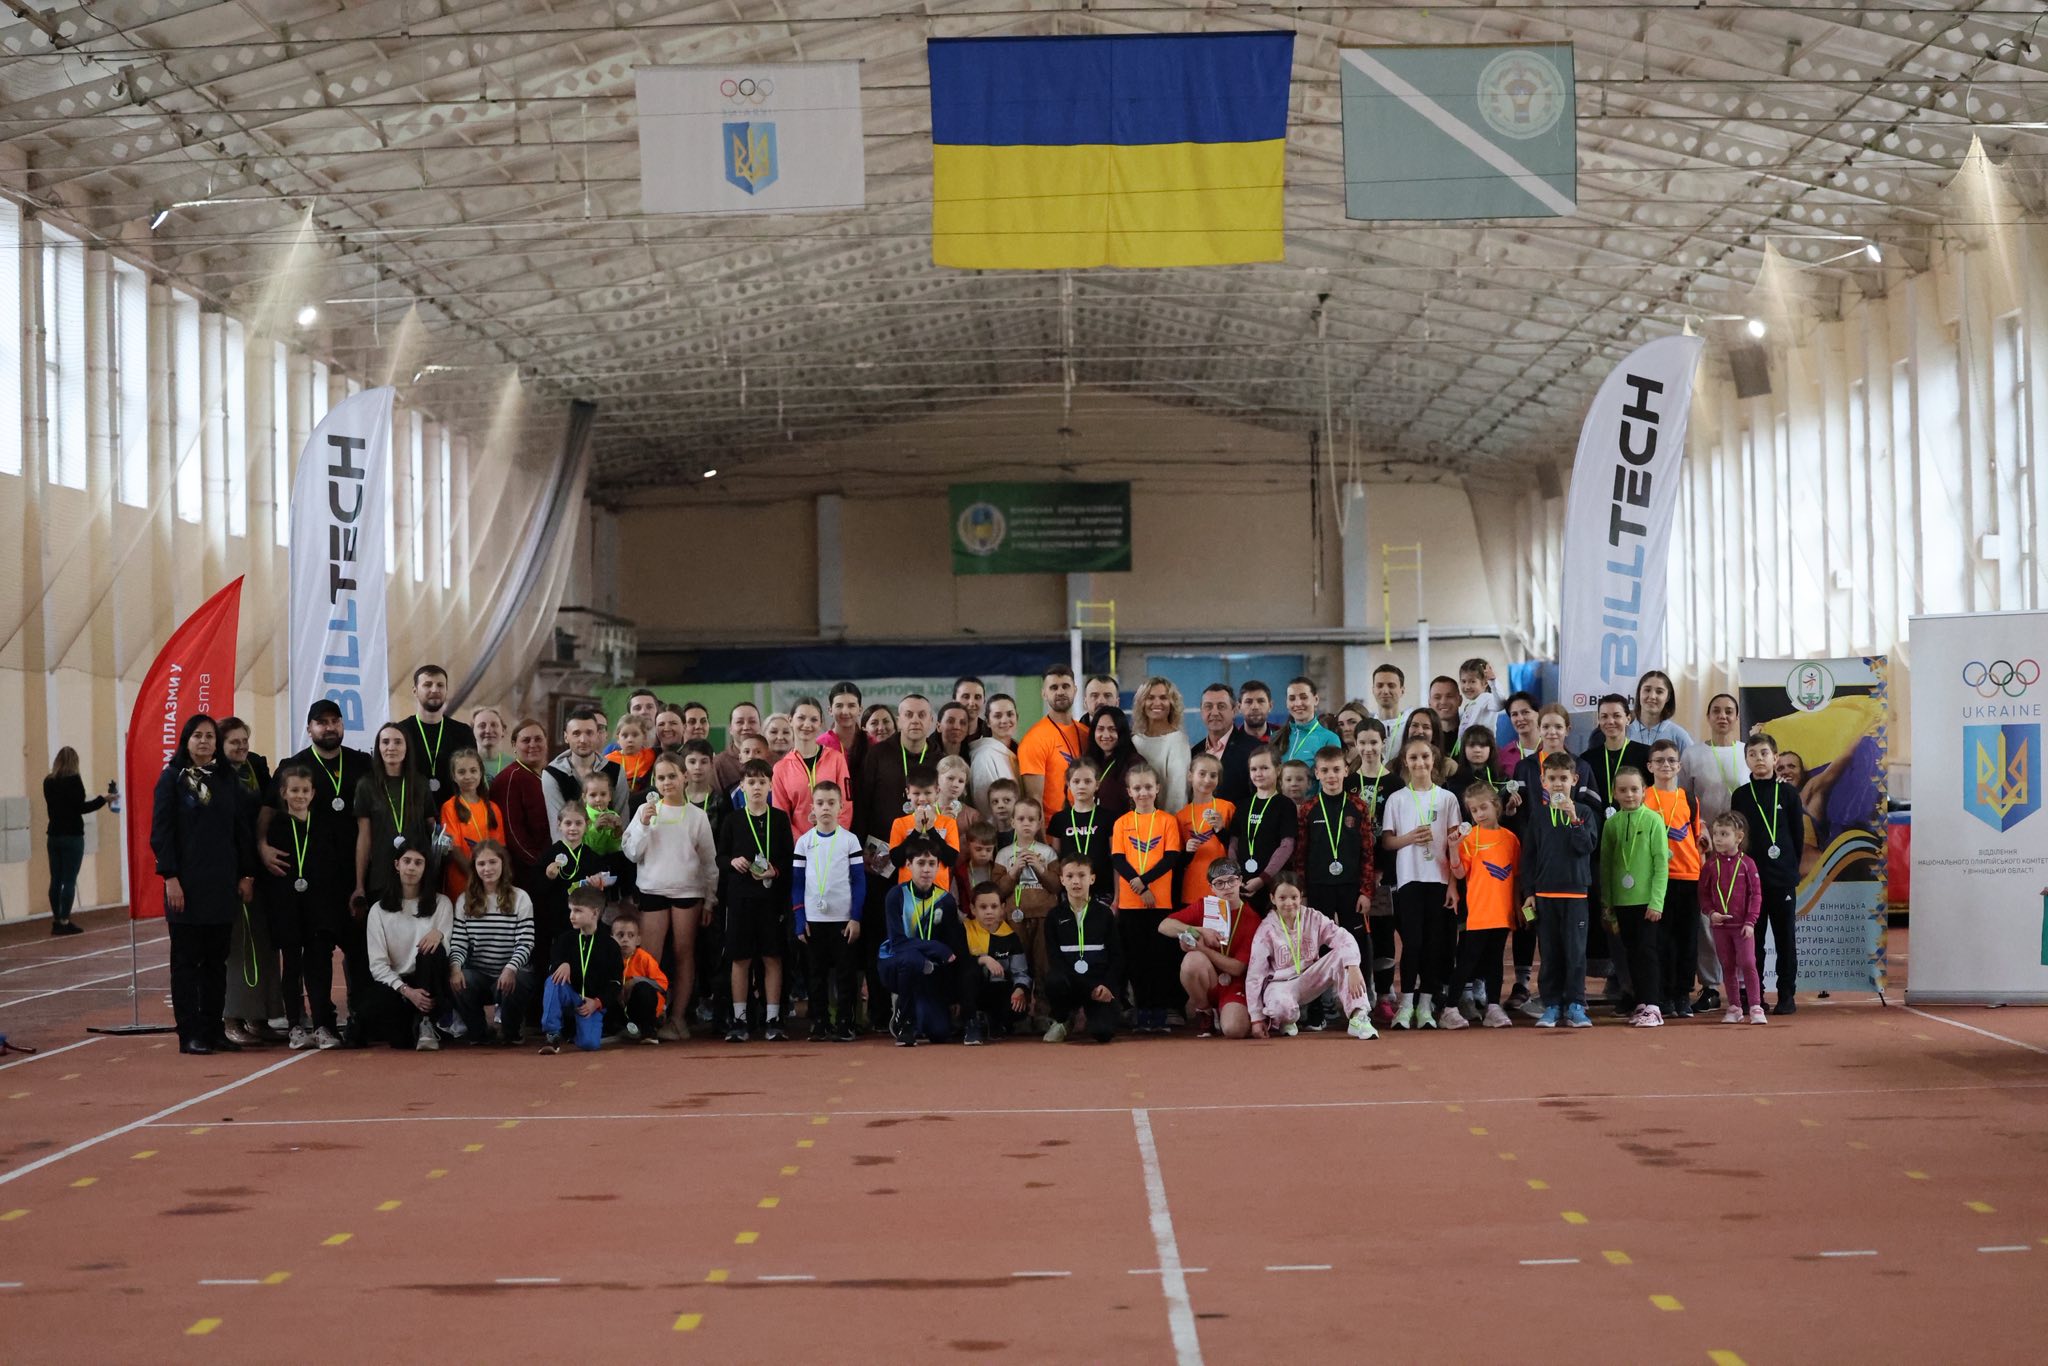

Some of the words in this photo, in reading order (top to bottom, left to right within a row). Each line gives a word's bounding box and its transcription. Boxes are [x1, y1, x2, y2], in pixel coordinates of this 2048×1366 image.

[1600, 374, 1664, 685] BILLTECH
[323, 435, 366, 731] BILLTECH
[198, 674, 210, 712] sma
[163, 677, 181, 744] ПЛАЗМИ
[1963, 704, 2041, 719] UKRAINE
[1065, 825, 1098, 836] ONLY
[1804, 970, 1816, 978] ДО
[1819, 970, 1866, 978] ТРЕНУВАНЬ
[1825, 959, 1866, 967] АТЛЕТИКИ
